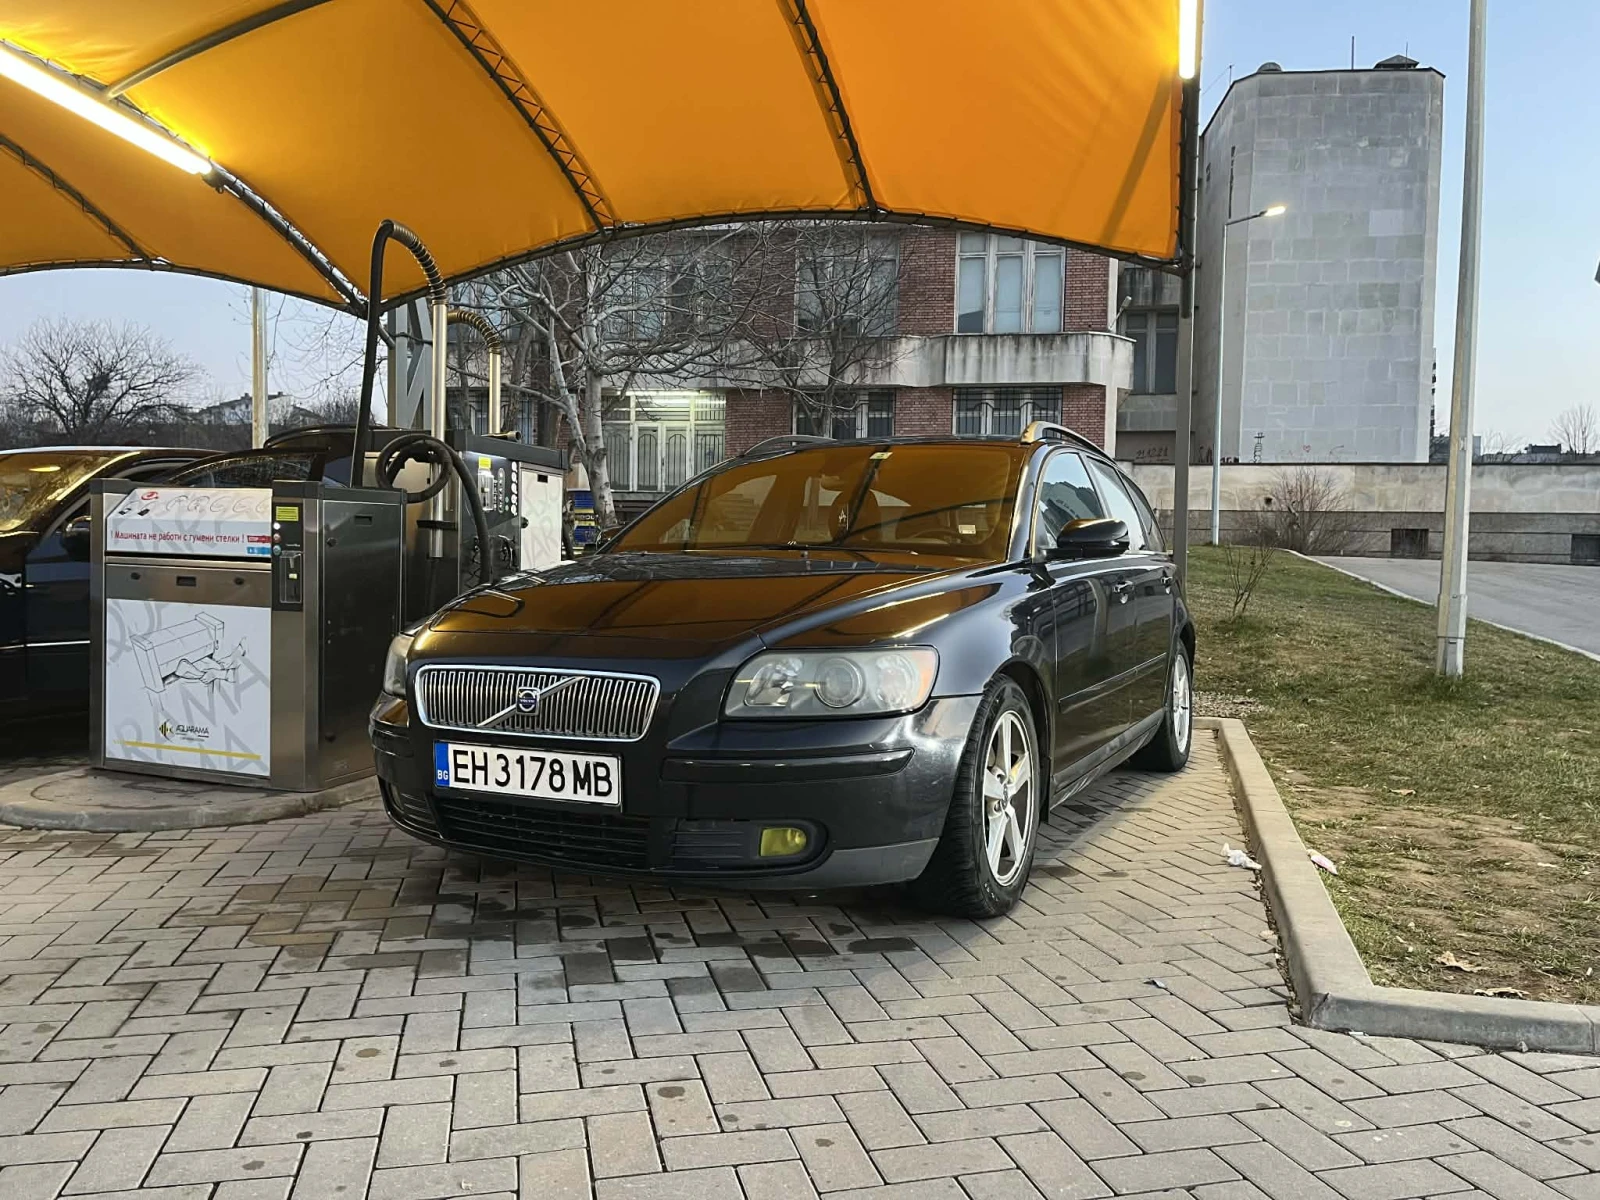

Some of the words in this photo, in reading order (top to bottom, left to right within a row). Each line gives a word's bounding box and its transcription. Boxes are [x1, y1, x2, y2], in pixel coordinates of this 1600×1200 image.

[114, 530, 147, 540] Машината
[158, 531, 182, 542] работи
[189, 533, 214, 544] гумени
[215, 534, 240, 543] стелки
[437, 769, 449, 781] BG
[494, 753, 566, 793] 3178
